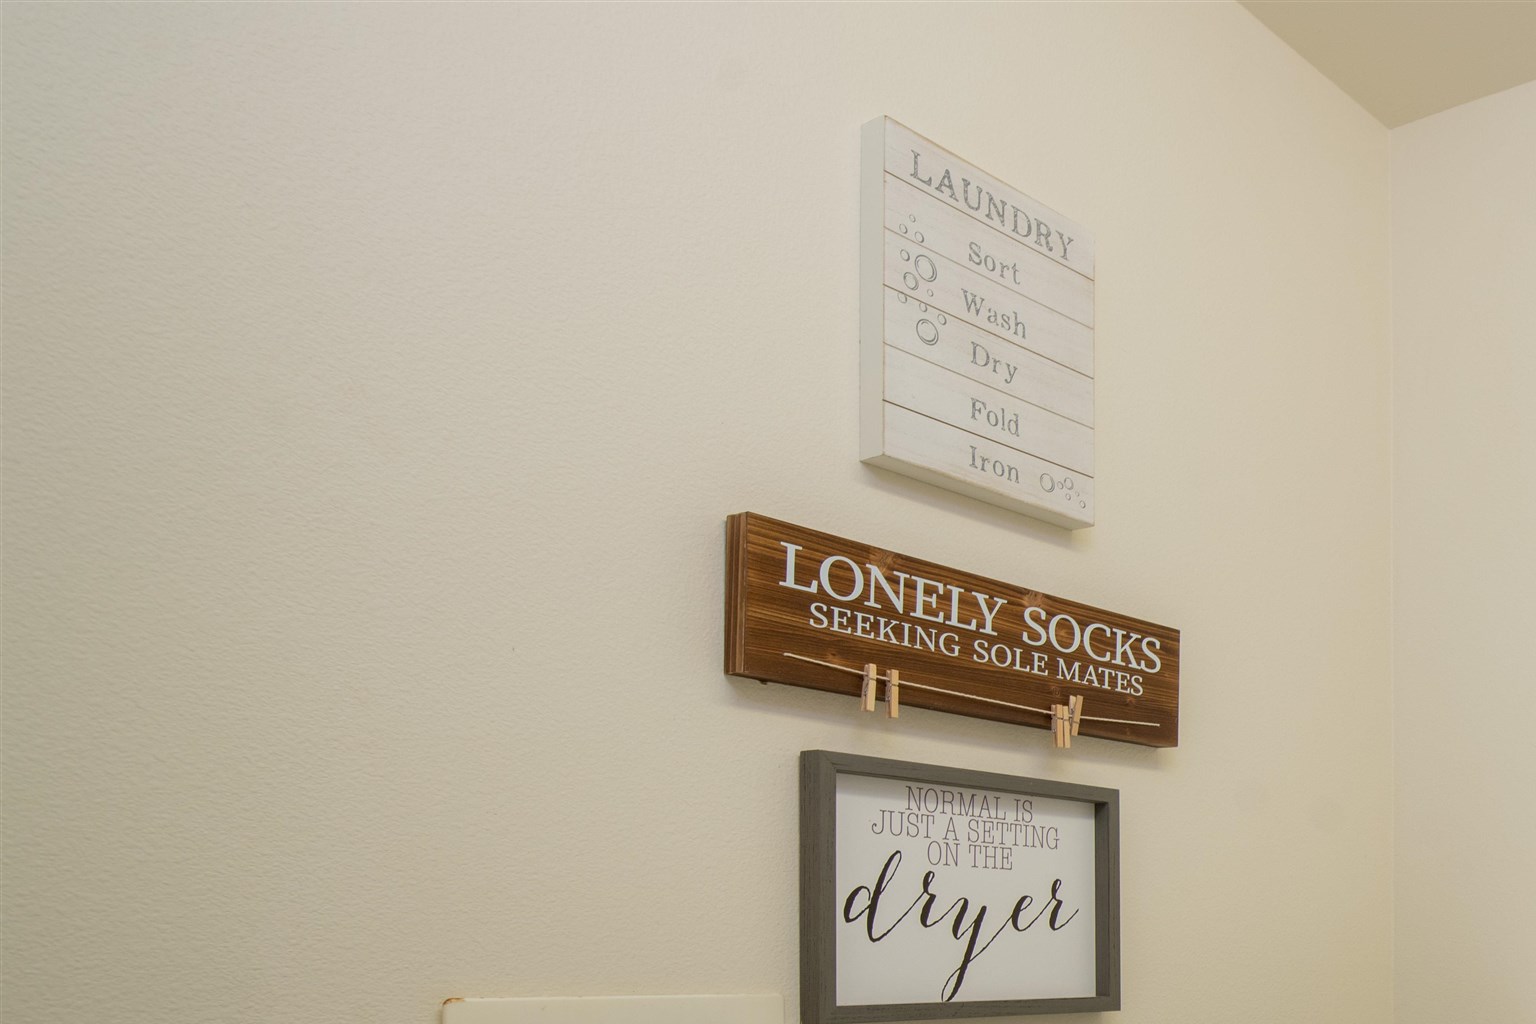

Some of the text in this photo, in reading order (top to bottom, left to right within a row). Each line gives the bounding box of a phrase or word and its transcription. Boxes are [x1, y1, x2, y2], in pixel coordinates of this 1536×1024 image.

[910, 149, 1074, 262] LAUNDRY
[968, 241, 1021, 286] Sort
[961, 288, 1027, 340] Wash
[971, 341, 1018, 385] Dry
[970, 397, 1020, 437] Fold
[969, 445, 1020, 484] Iron
[778, 540, 1162, 674] LONELY SOCKS
[808, 602, 1144, 696] SEEKING SOLE MATES
[905, 785, 1033, 823] NORMAL IS
[871, 809, 1060, 850] JUST A SETTING
[927, 841, 1013, 870] ON THE
[844, 850, 1080, 1002] dryer
